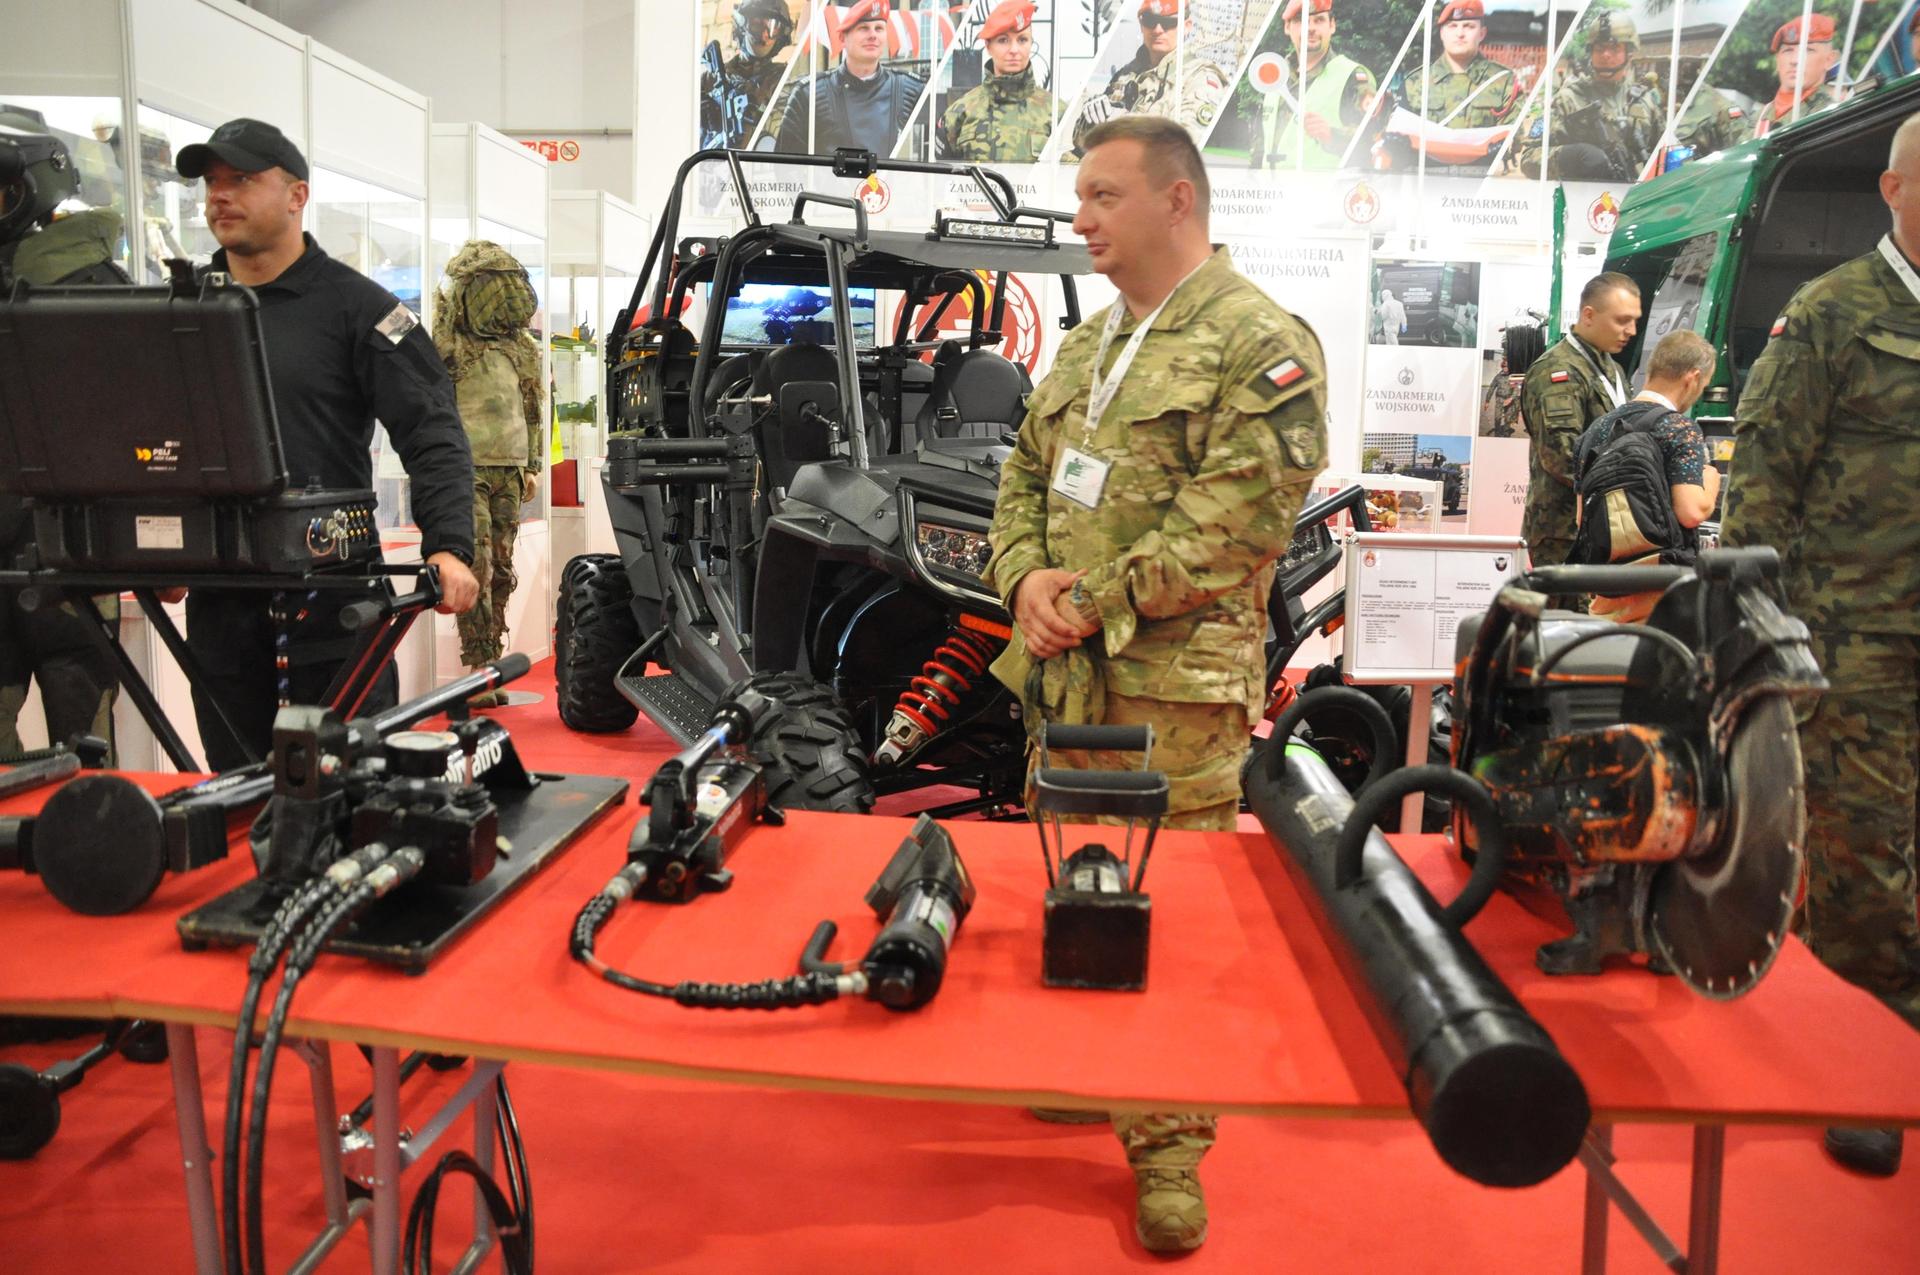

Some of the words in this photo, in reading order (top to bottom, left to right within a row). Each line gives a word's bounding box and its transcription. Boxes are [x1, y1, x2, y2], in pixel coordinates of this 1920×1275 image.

[719, 181, 805, 192] ŻADARMERIA
[1212, 188, 1285, 200] NDARMERIA
[730, 197, 795, 208] WSKOWA
[1441, 195, 1529, 210] ŻANDARMERIA
[1451, 213, 1518, 226] WOJSKOWA
[1231, 243, 1345, 262] ŻANDARMERIA
[1245, 262, 1331, 278] WOJSKOWA
[1375, 401, 1436, 413] WOJSKOWA
